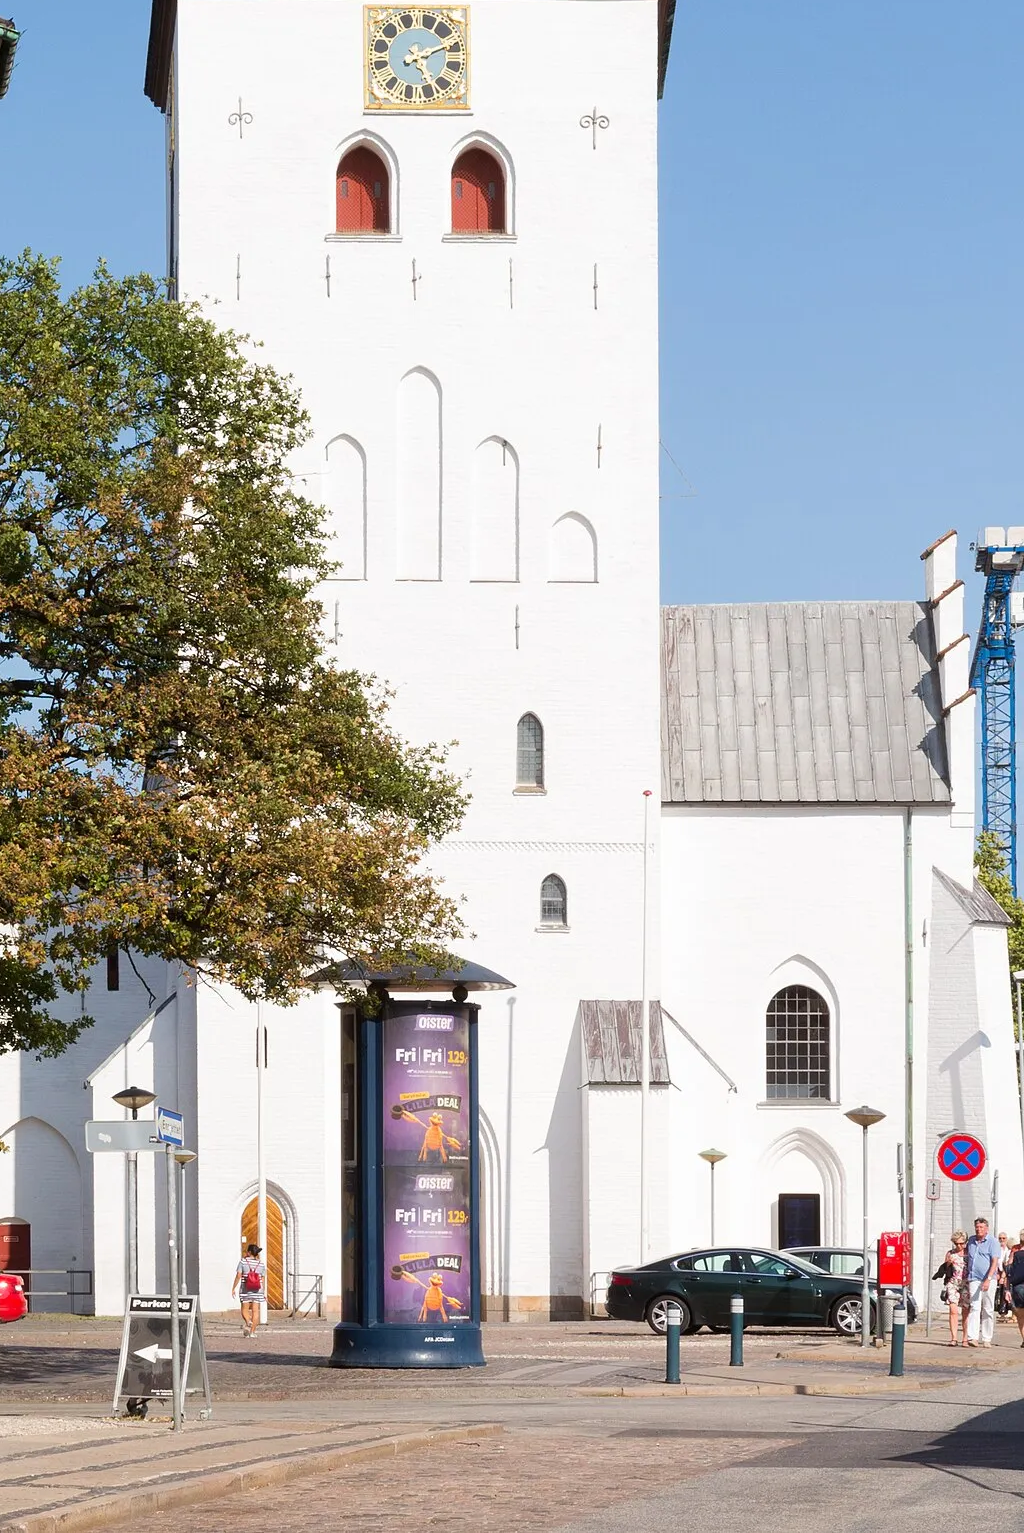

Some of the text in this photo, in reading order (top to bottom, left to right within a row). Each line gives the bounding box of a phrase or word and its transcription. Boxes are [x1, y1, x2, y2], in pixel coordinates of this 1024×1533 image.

[396, 1048, 416, 1061] Fri
[423, 1048, 442, 1062] Fri
[437, 1097, 459, 1109] DEAL
[395, 1208, 416, 1222] Fri
[422, 1208, 442, 1222] Fri
[405, 1257, 459, 1272] LILLA DEAL
[132, 1299, 190, 1310] Parkerng
